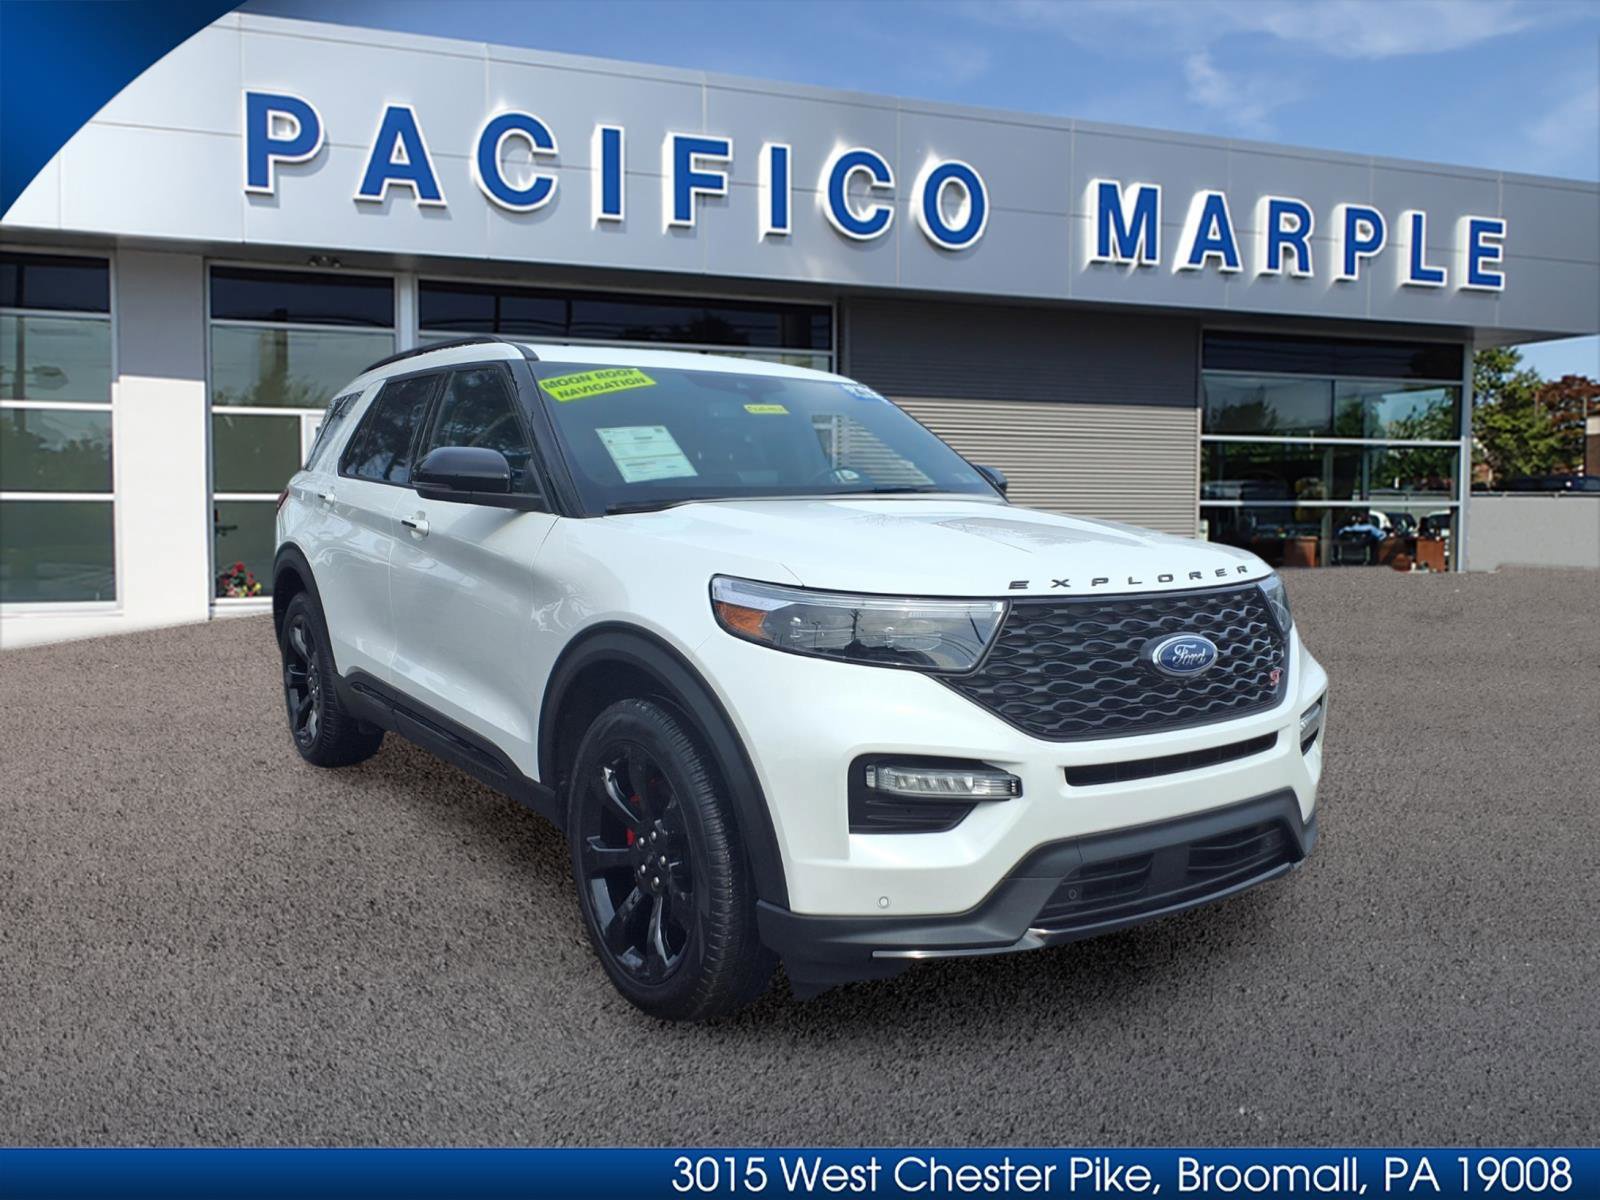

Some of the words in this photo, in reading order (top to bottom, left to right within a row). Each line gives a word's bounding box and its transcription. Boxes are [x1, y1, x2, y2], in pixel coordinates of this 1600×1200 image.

[243, 88, 990, 250] PACIFICO
[1085, 178, 1507, 292] MARPLE
[541, 373, 593, 390] MOON
[556, 376, 647, 399] NAVIGATION
[1008, 565, 1248, 590] EXPLORER
[1172, 643, 1207, 667] Ford
